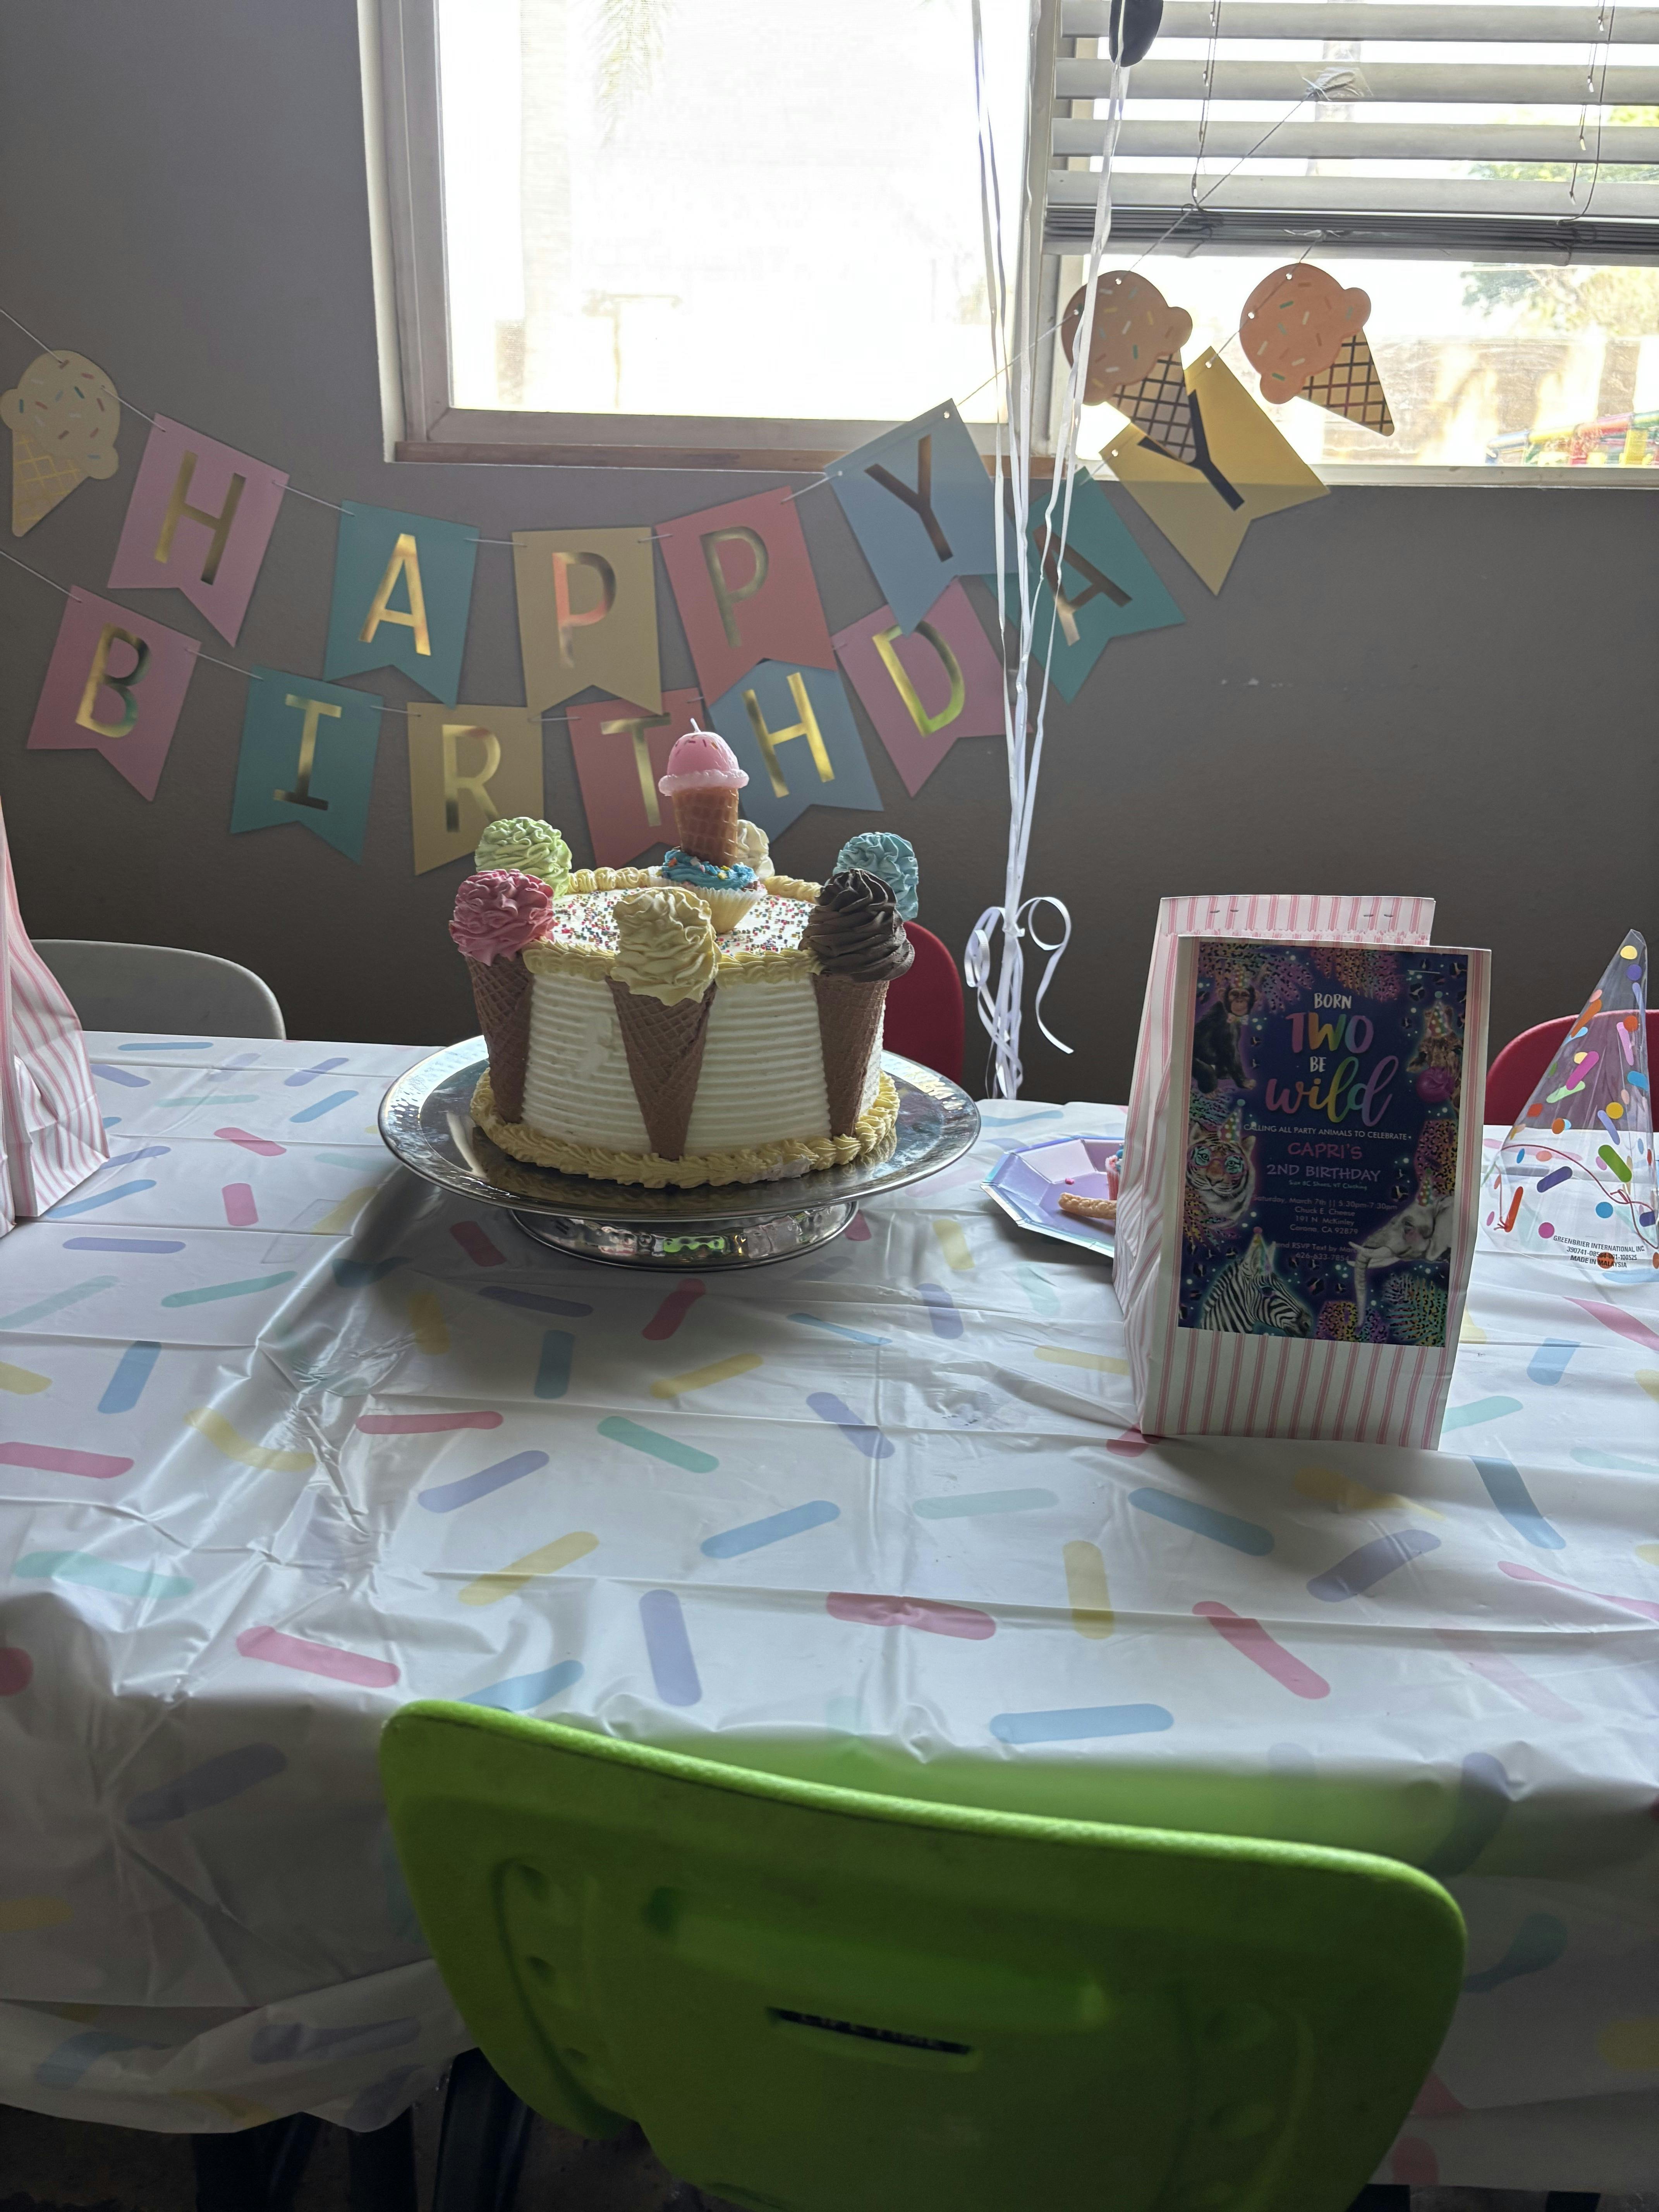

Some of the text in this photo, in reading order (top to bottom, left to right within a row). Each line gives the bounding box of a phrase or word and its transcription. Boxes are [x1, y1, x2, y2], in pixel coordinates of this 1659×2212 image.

[154, 435, 953, 668] HAPPY
[75, 390, 1244, 833] BIRTHDAY
[1314, 993, 1352, 1009] BORN
[1286, 1012, 1374, 1054] TWO
[1310, 1056, 1326, 1072] BE
[1266, 1055, 1399, 1127] wild
[1318, 1128, 1352, 1137] ANIMALS
[1367, 1132, 1407, 1140] CELEBRATE
[1288, 1142, 1363, 1159] CAPRI'S
[1267, 1164, 1382, 1182] 2ND BIRTHDAY
[1295, 1206, 1317, 1214] Chuck
[1328, 1208, 1355, 1216] Cheese
[1322, 1218, 1355, 1226] McKinley
[1312, 1243, 1327, 1251] Text
[1553, 1235, 1589, 1248] GREENBRIER
[1591, 1243, 1635, 1252] INTERNATIONAL
[1570, 1255, 1588, 1264] MADE
[1597, 1260, 1627, 1268] MALAYSIA
